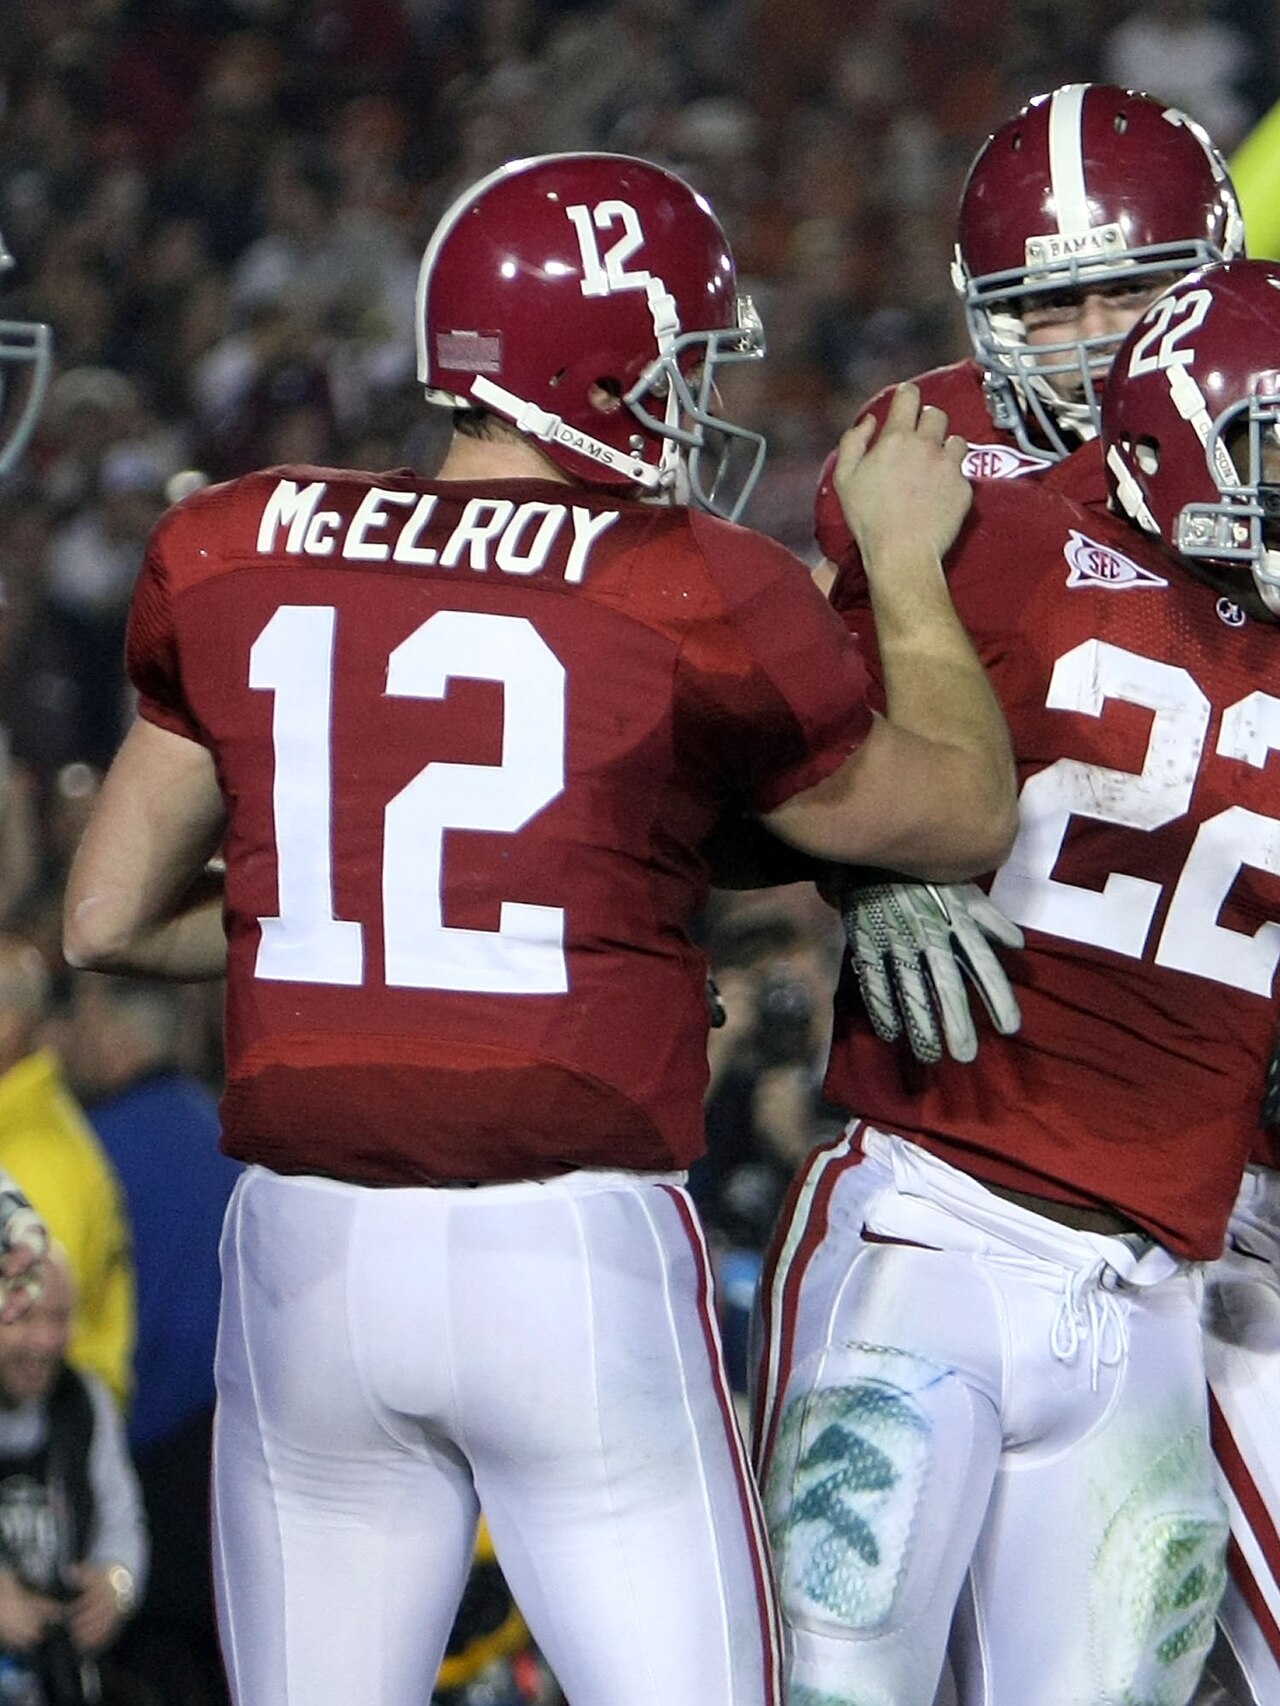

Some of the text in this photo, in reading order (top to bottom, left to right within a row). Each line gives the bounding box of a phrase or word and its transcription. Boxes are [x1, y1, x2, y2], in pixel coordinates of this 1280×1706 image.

[566, 200, 650, 297] 12
[1049, 235, 1102, 257] BAMA
[1128, 289, 1213, 378] 22
[967, 451, 1002, 478] SEC
[1088, 550, 1120, 580] SEC
[248, 605, 569, 994] 12
